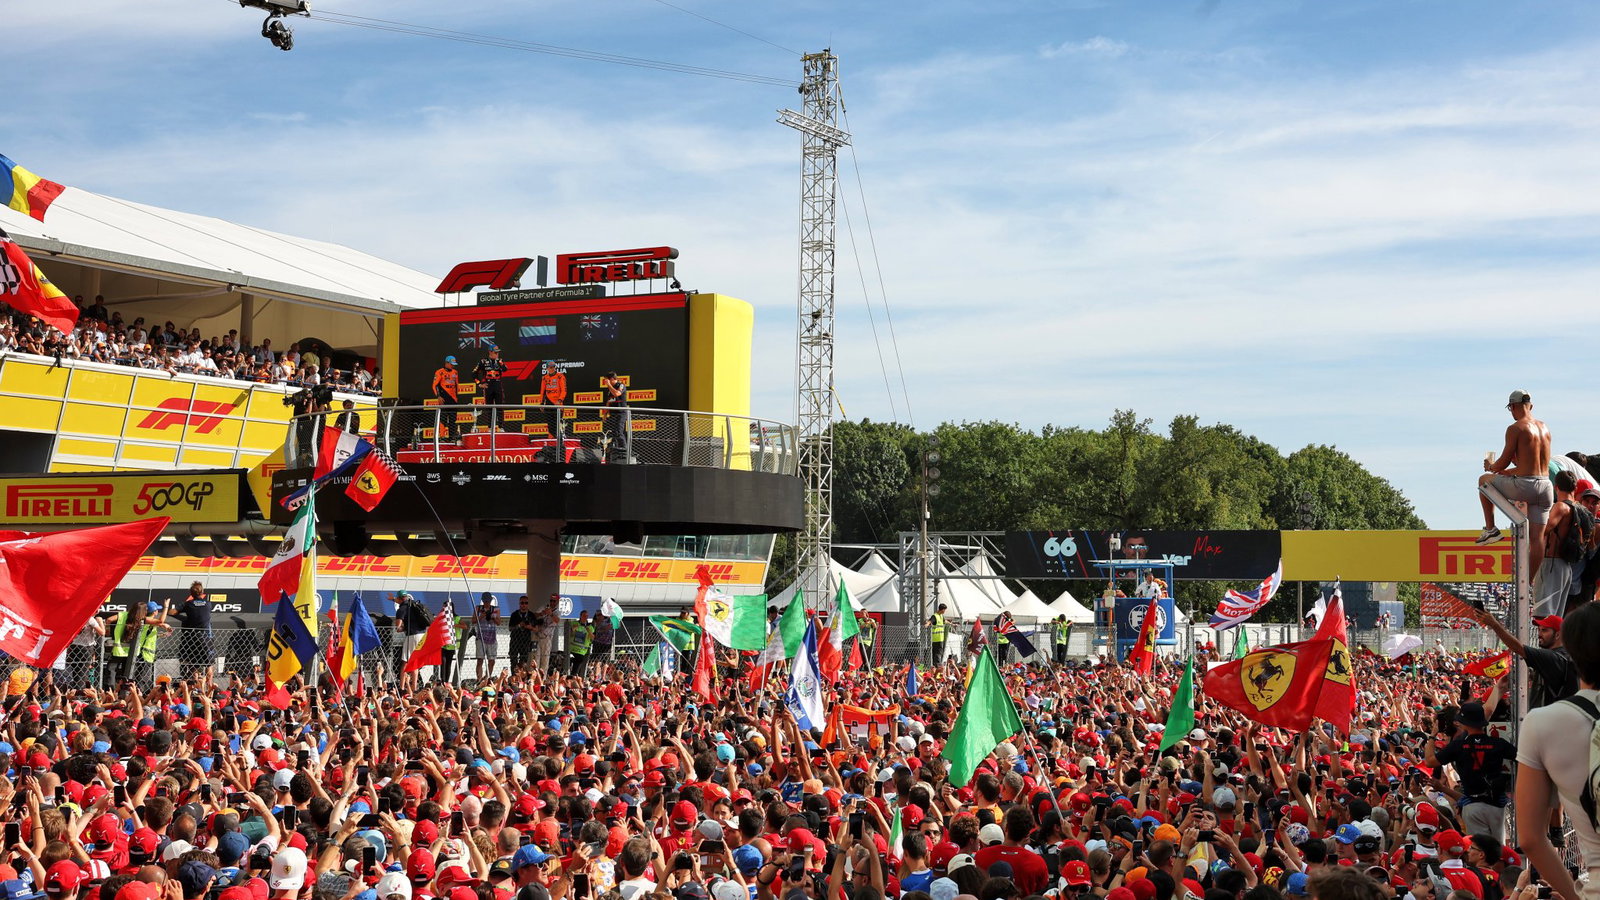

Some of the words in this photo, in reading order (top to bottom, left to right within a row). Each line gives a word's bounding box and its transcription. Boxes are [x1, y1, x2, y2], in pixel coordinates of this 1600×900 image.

[556, 246, 679, 285] PIRELLI
[480, 294, 501, 303] Global
[503, 293, 518, 302] Tyre
[520, 291, 545, 300] Partner
[555, 288, 584, 297] Formula
[136, 397, 237, 434] F1
[477, 436, 484, 445] 1
[333, 476, 353, 485] LVMH
[6, 483, 114, 516] PIRELLI
[1043, 536, 1078, 557] 66
[1193, 535, 1223, 558] Max
[432, 554, 489, 574] DHL
[615, 561, 661, 578] DHL
